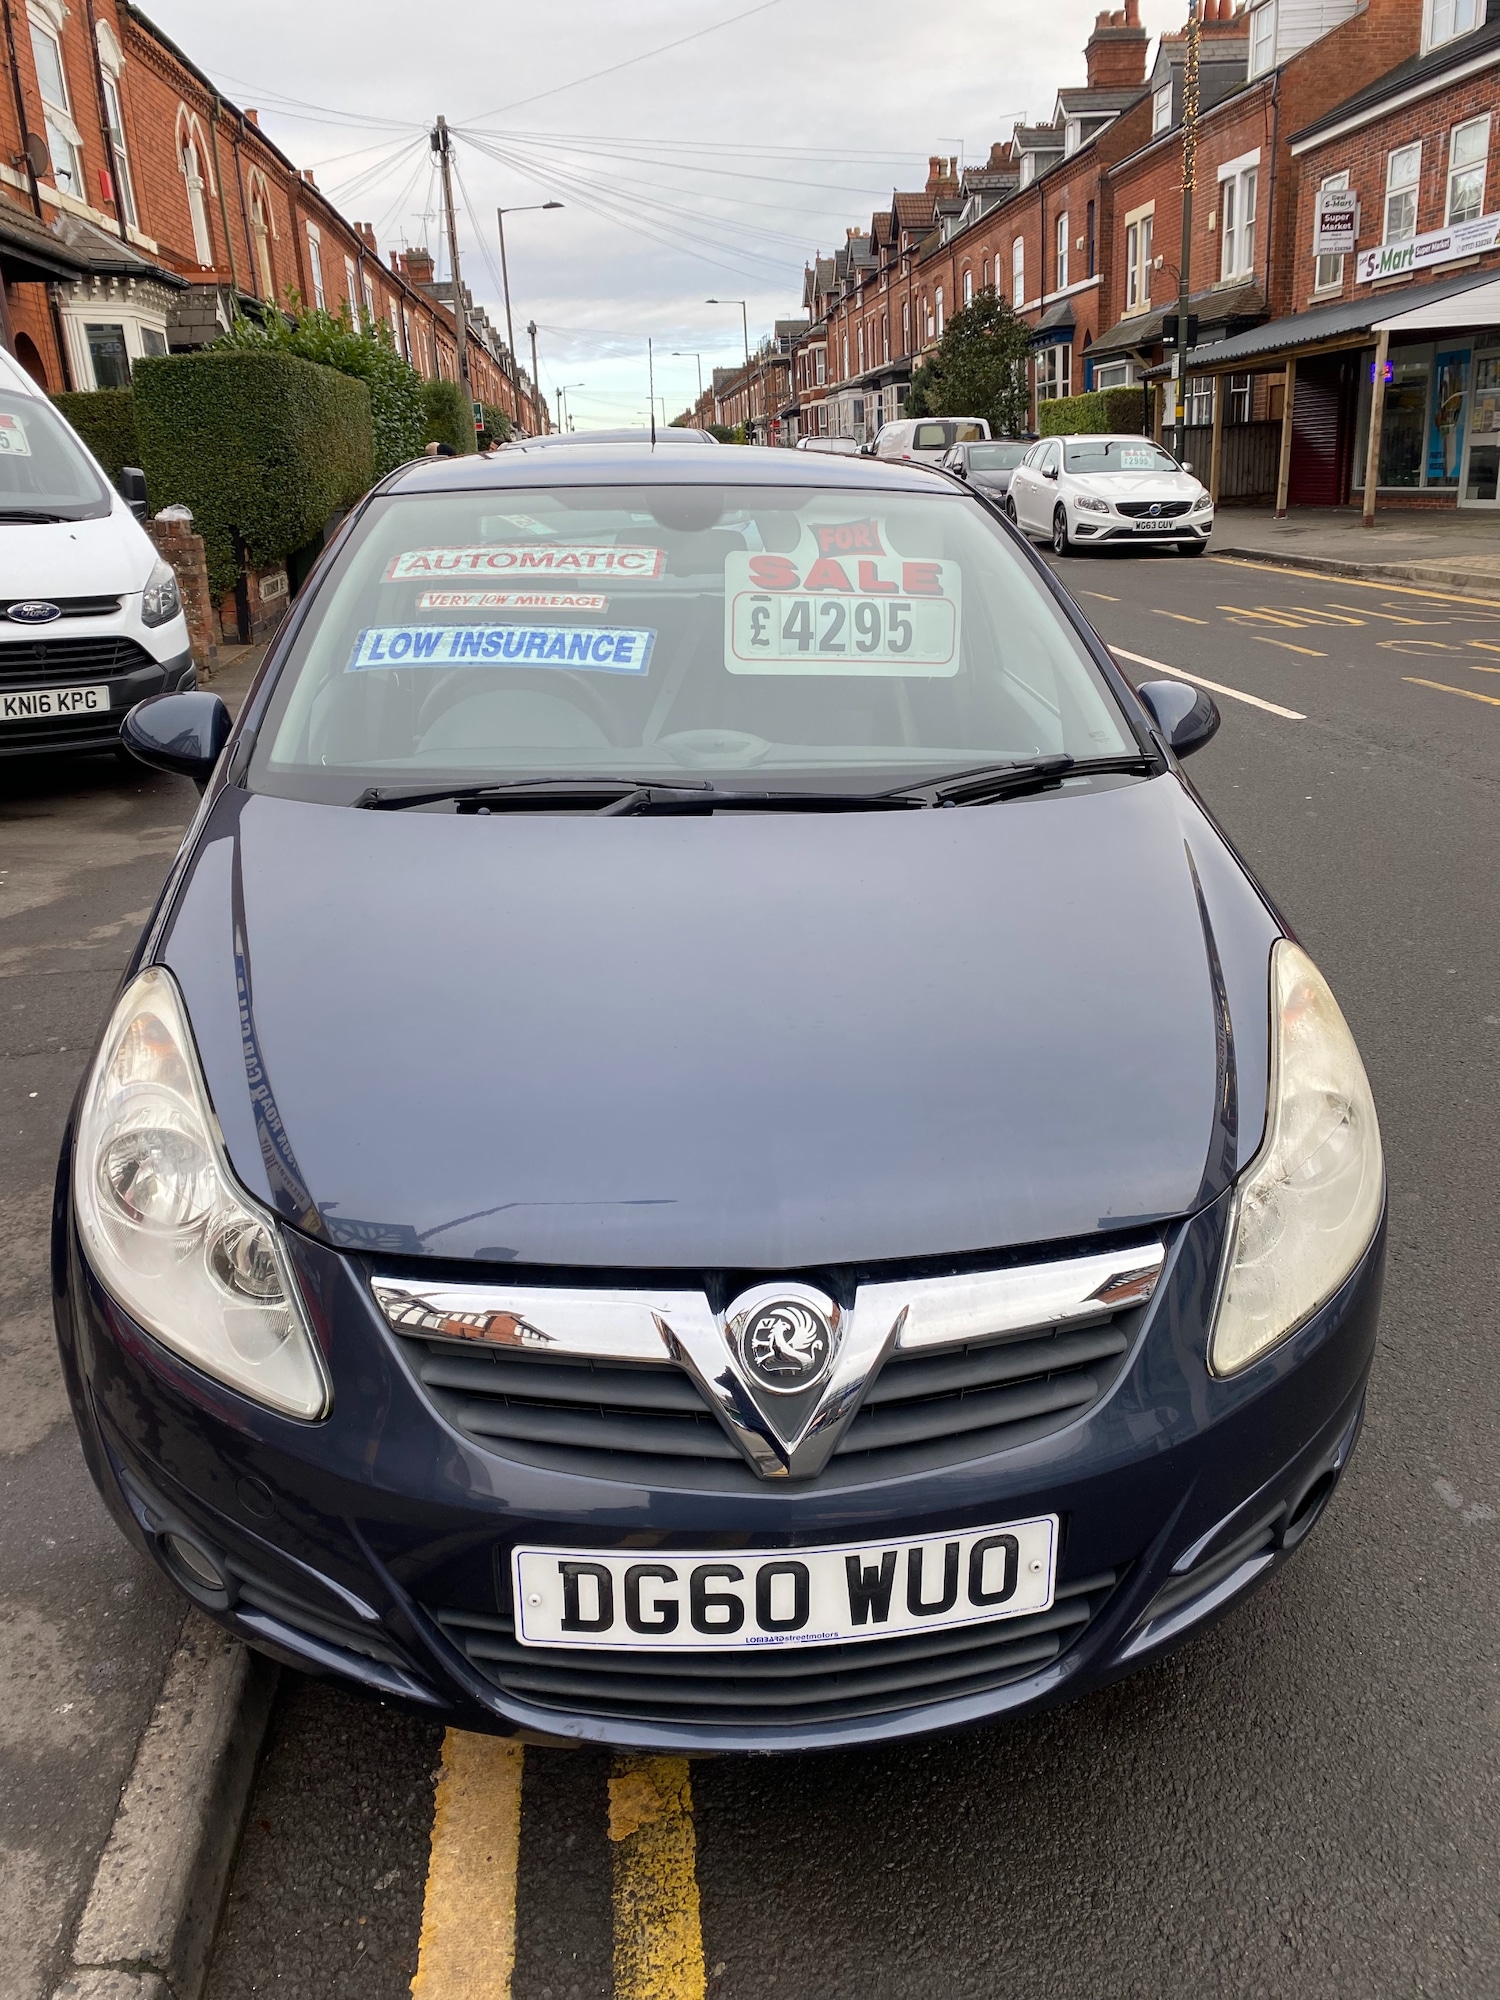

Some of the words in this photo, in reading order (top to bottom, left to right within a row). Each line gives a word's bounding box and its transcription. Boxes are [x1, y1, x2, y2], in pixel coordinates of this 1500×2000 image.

[1325, 200, 1352, 208] S-Mart
[1321, 222, 1352, 231] Market
[1324, 214, 1350, 222] Super
[1416, 243, 1431, 256] Super
[1431, 239, 1450, 251] Market
[1365, 243, 1415, 277] S-Mart
[818, 523, 873, 552] FOR
[404, 552, 648, 571] AUTOMATIC
[748, 555, 944, 595] SALE
[21, 604, 50, 617] Ford
[429, 594, 475, 606] VERY
[478, 595, 510, 606] LOW
[514, 596, 601, 607] MILEAGE
[750, 600, 913, 652] £4295
[368, 631, 440, 660] LOW
[450, 631, 636, 663] INSURANCE
[4, 694, 51, 716] KN16
[57, 690, 97, 712] KPG
[558, 1560, 810, 1635] DG60
[845, 1533, 1019, 1626] WUO
